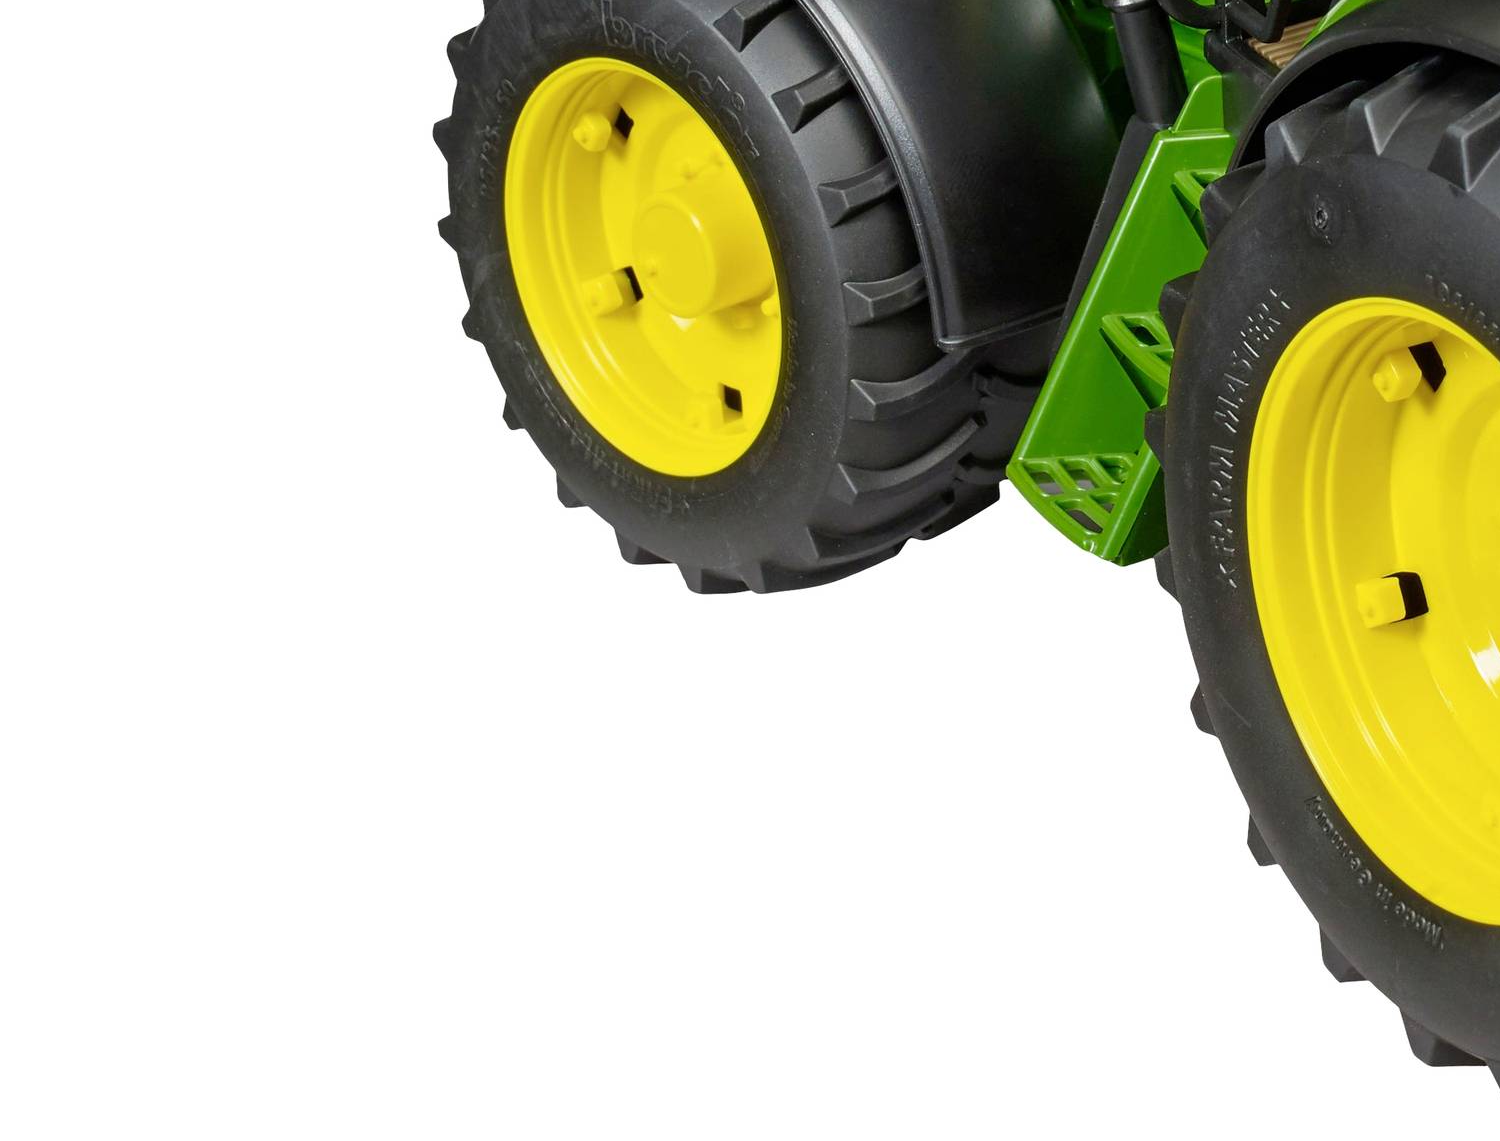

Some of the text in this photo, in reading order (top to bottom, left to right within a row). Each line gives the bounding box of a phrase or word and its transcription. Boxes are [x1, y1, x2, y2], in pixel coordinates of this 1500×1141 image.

[1209, 302, 1281, 556] FARM MASTER
[1303, 794, 1446, 953] Made in Germany
